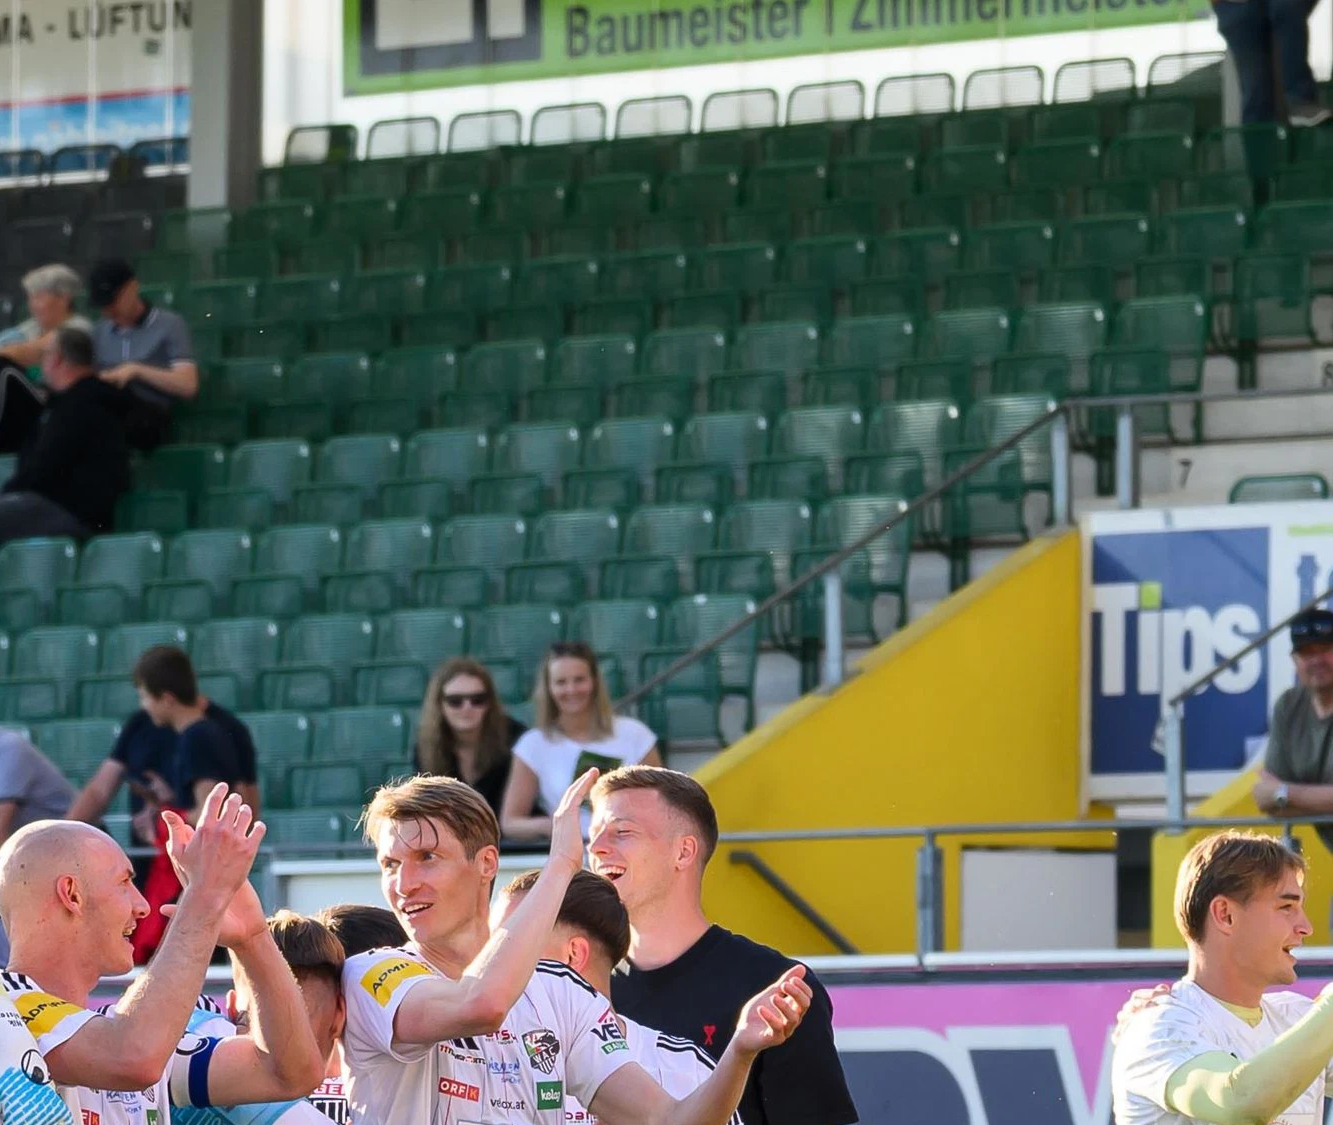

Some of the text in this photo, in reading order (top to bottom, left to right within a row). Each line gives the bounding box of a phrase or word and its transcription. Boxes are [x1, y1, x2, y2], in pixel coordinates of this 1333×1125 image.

[566, 2, 805, 58] Baumeister
[1091, 581, 1262, 720] Tips
[532, 1046, 558, 1068] WAC
[440, 1080, 480, 1101] ORF K
